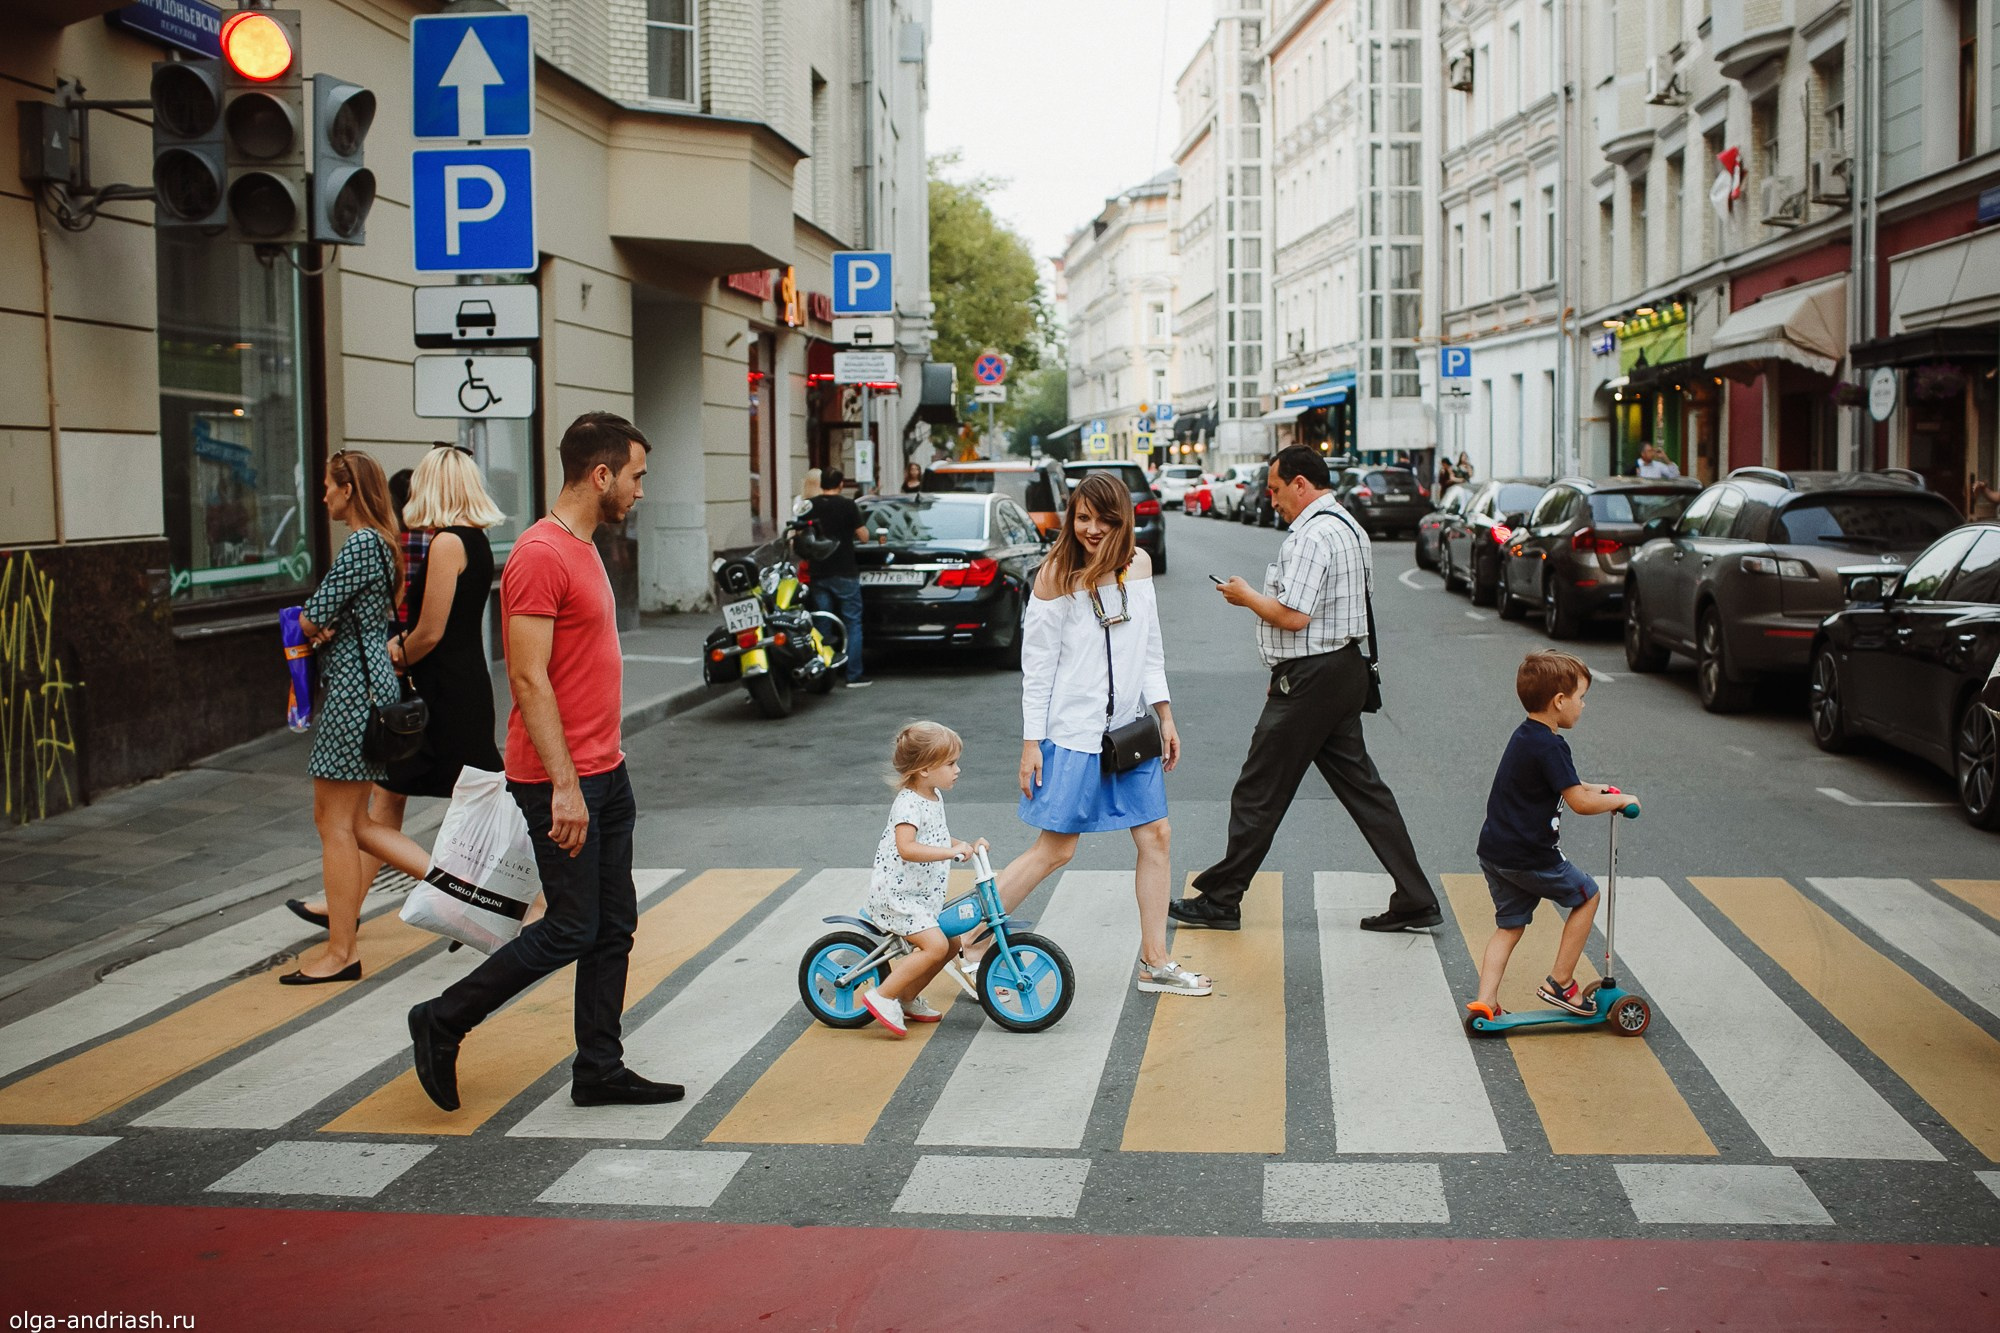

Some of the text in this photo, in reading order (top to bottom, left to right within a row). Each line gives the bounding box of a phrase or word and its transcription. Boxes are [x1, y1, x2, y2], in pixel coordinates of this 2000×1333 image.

[444, 164, 507, 256] P
[848, 260, 880, 306] P
[1447, 350, 1466, 375] P
[747, 614, 760, 626] 77
[488, 854, 532, 875] ONLINE
[448, 882, 503, 908] CARLO PAZOLINI
